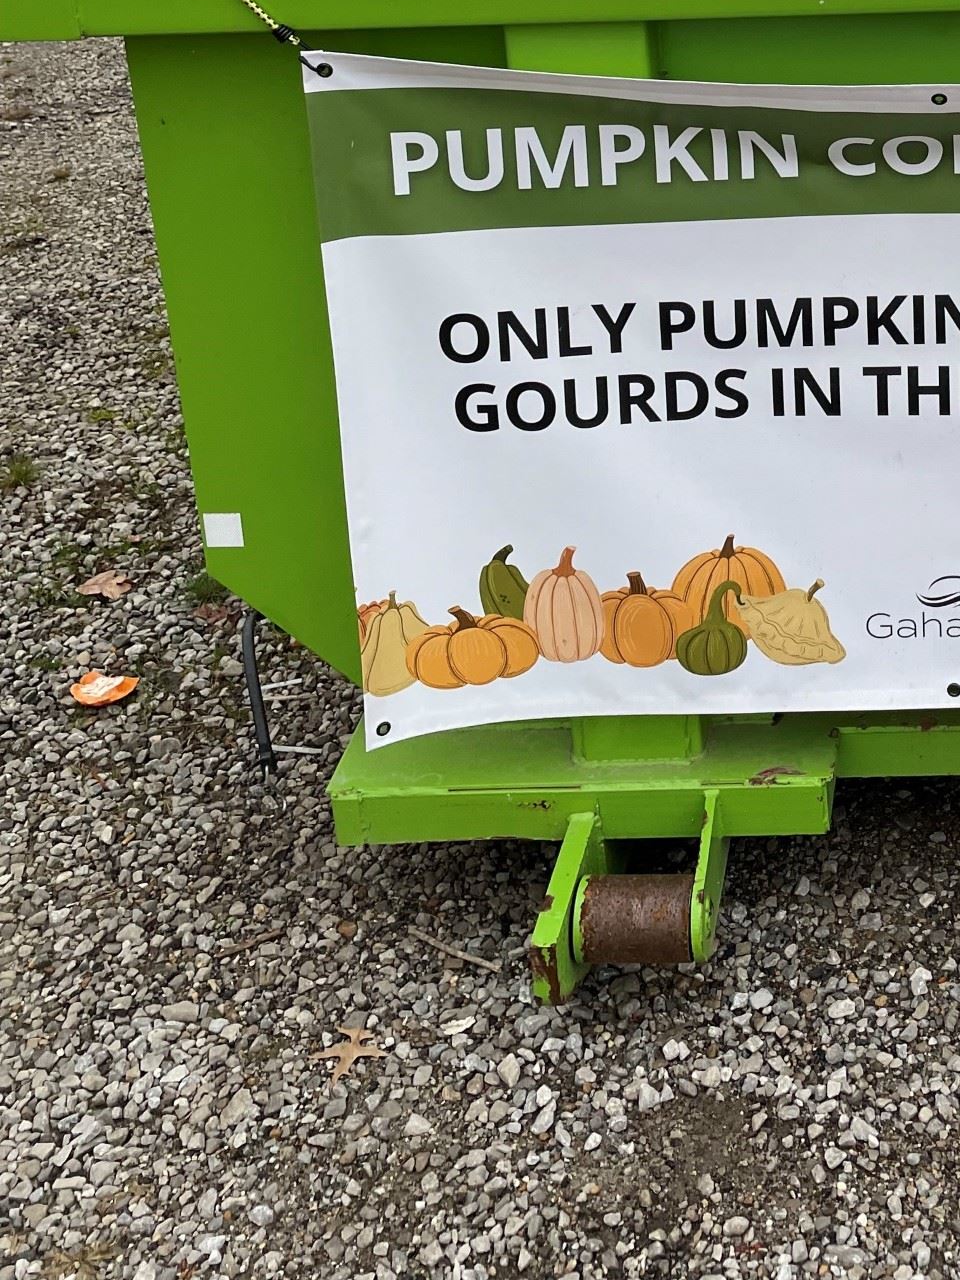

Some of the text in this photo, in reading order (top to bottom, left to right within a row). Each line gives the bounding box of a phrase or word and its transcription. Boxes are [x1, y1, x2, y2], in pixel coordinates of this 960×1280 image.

[389, 123, 800, 197] PUMPKIN
[438, 302, 637, 364] ONLY
[454, 368, 749, 433] GOURDS
[772, 366, 842, 417] IN
